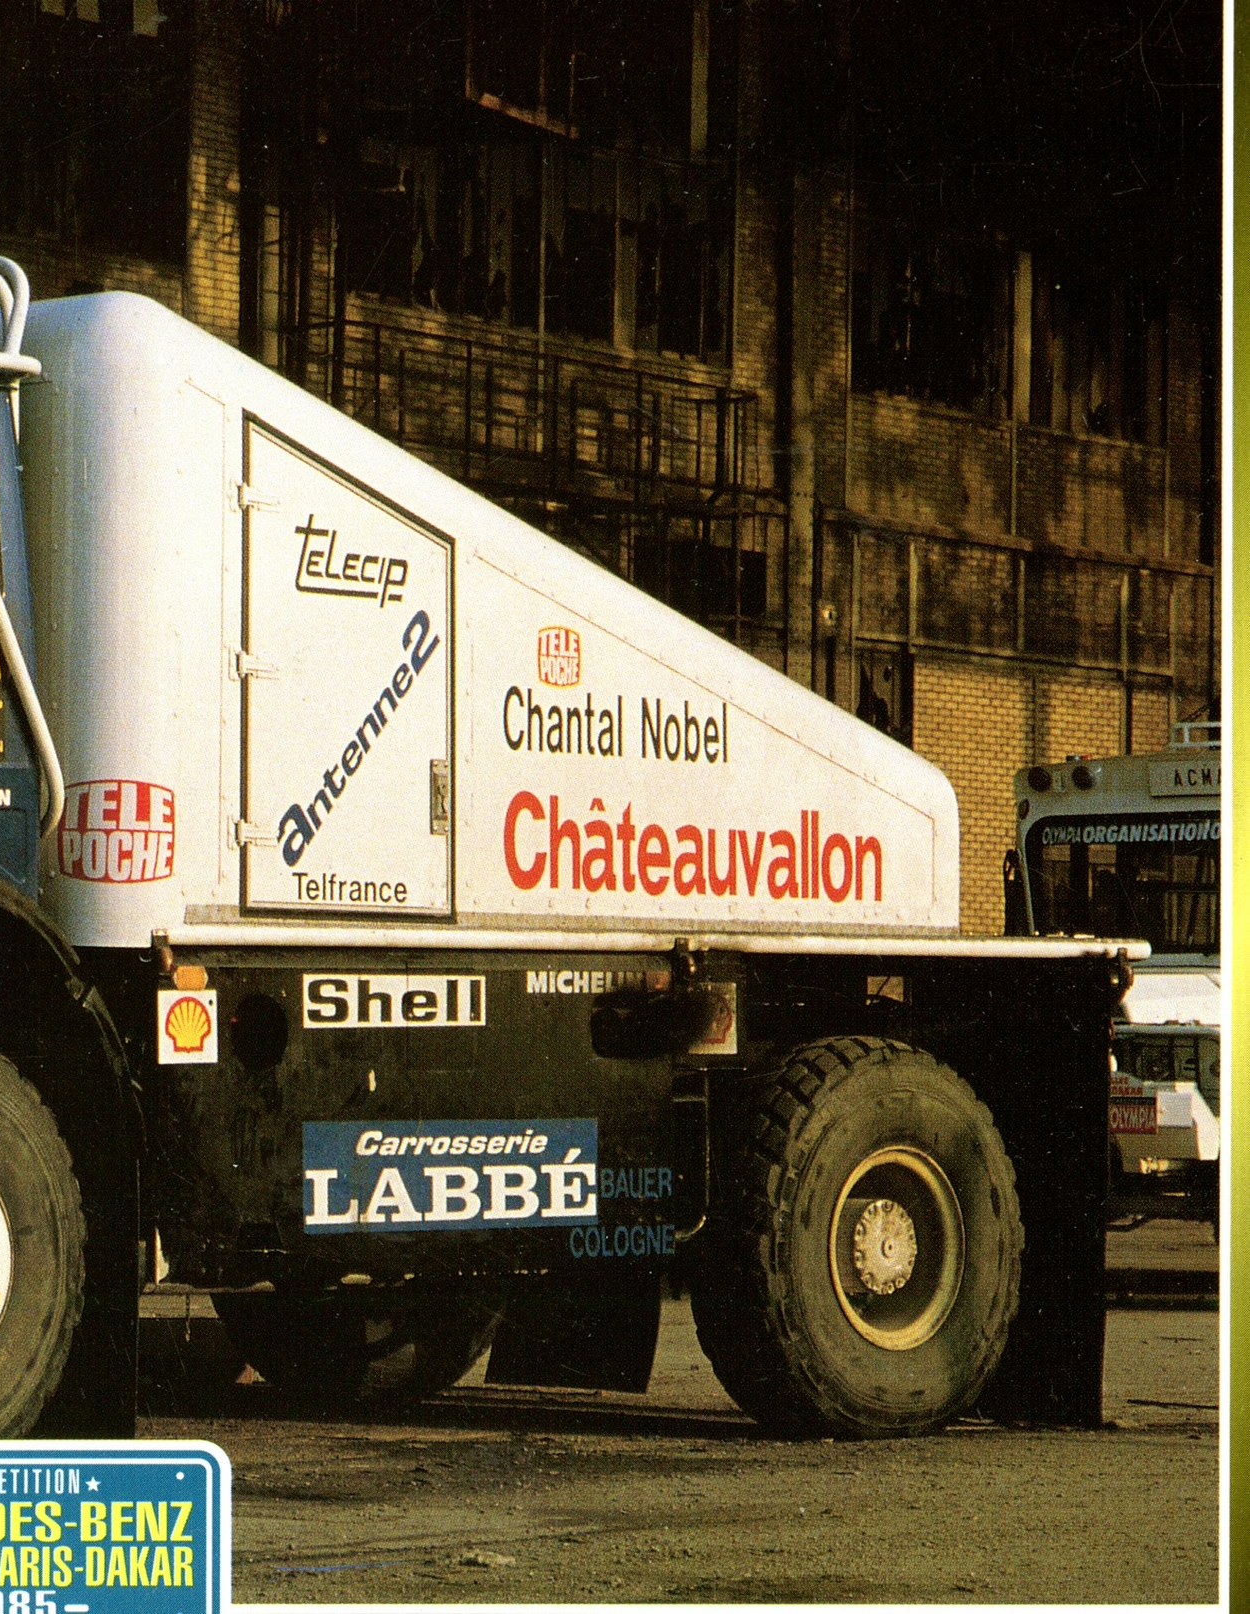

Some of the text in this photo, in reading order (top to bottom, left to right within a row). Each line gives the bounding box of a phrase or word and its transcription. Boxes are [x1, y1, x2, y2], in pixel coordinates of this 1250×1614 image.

[538, 629, 579, 657] TELE
[539, 656, 579, 685] POCHE
[503, 686, 728, 763] Chantal Nobel
[1174, 768, 1221, 786] ACM
[64, 782, 172, 832] TELE
[62, 830, 172, 881] POCHE
[504, 790, 882, 903] Châteauvallon
[292, 873, 408, 903] Telfrance
[526, 970, 643, 994] MICHELIN
[307, 979, 483, 1024] Shell
[1111, 1105, 1156, 1129] OLYMPIA
[356, 1130, 548, 1155] Carrosserie
[305, 1148, 597, 1225] LABBÉ
[600, 1167, 672, 1198] BAUER
[570, 1224, 675, 1259] COLOGNE
